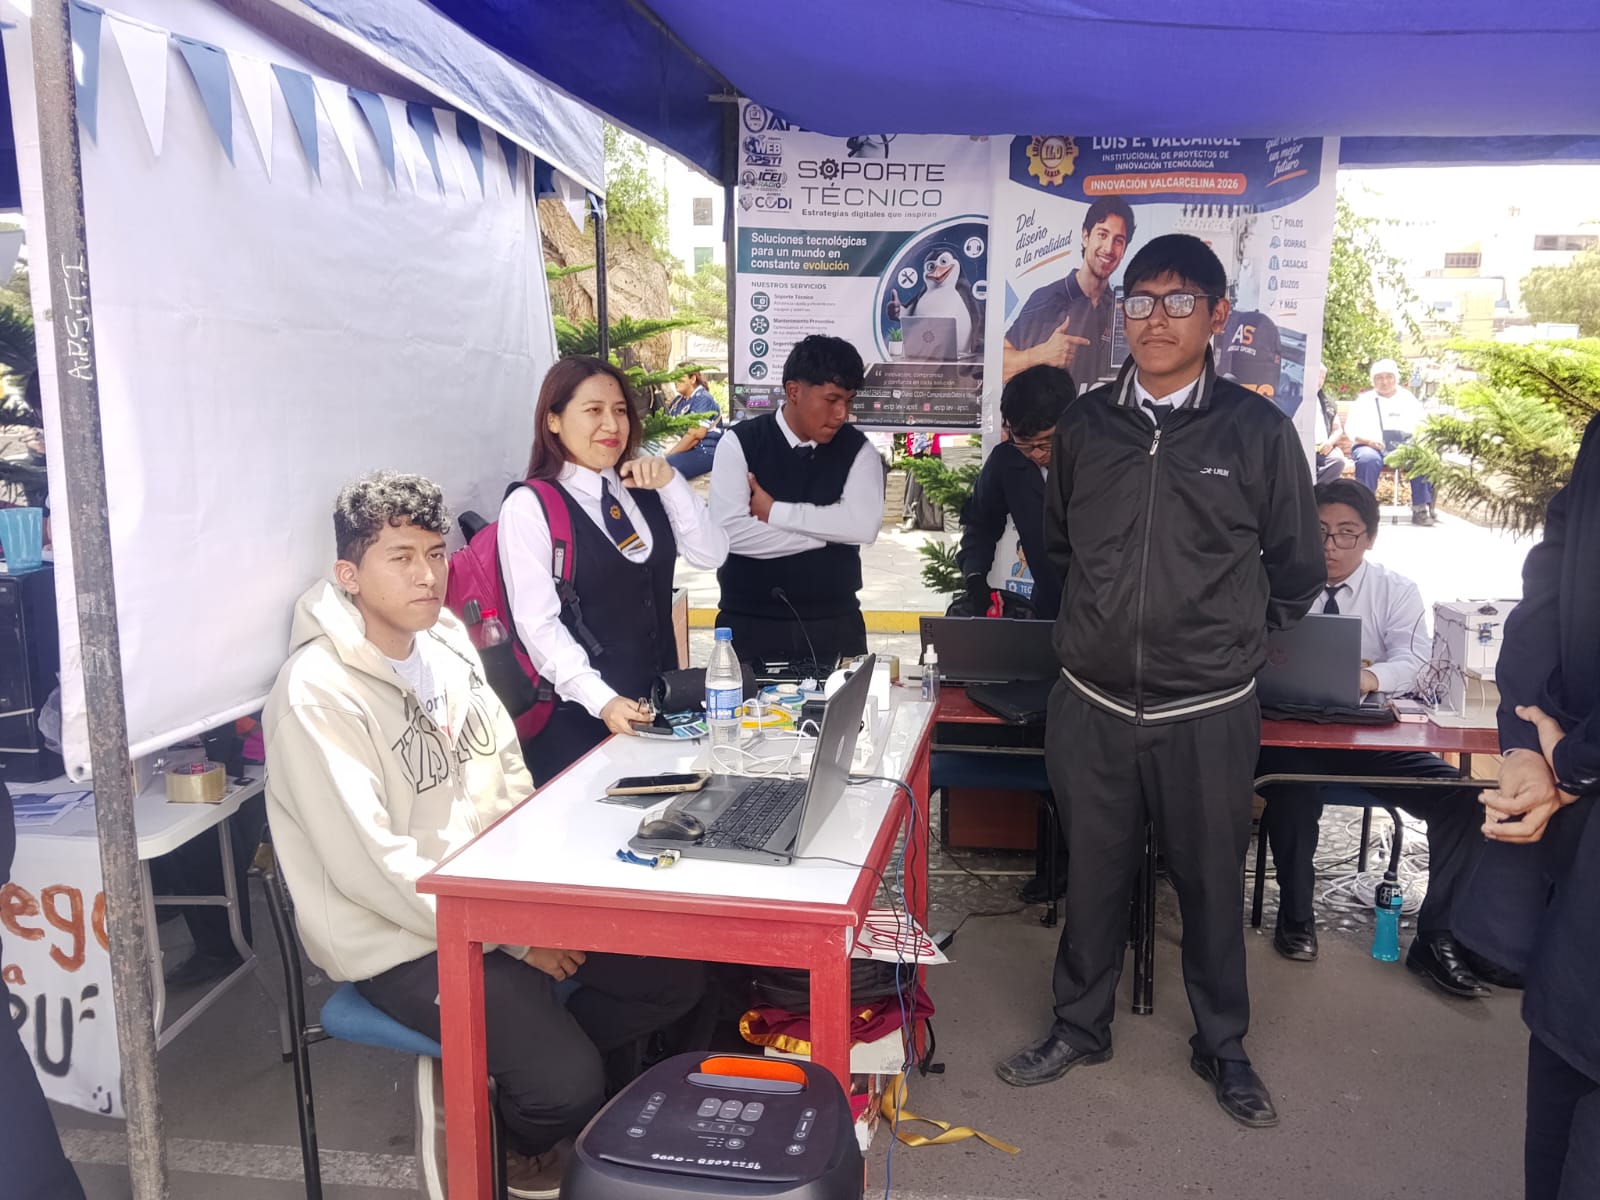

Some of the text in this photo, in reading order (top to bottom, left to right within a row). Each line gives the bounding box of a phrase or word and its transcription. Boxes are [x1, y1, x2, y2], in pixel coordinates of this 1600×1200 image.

[1093, 136, 1128, 150] LUIS
[1102, 150, 1230, 162] INSTITUCIONAL DE PROYECTOS DE
[798, 158, 946, 181] SOPORTE
[1115, 158, 1214, 171] INNOVACIÓN TECNOLÓGICA
[1091, 177, 1239, 190] INNOVACIÓN VALCARCELINA 2026
[800, 182, 942, 207] TÉCNICO
[802, 208, 849, 219] Estrategias
[851, 210, 885, 219] digitales
[904, 211, 937, 219] inspiran
[1016, 208, 1036, 234] Del
[1284, 218, 1304, 228] POLOS
[751, 232, 868, 248] Soluciones tecnológicas
[1015, 225, 1048, 251] diseño
[1283, 238, 1307, 248] GORRAS
[751, 246, 841, 259] para un mundo en
[1023, 249, 1032, 264] la
[1033, 229, 1073, 259] realidad
[750, 260, 850, 271] constante evolución
[1282, 258, 1308, 269] CASACAS
[751, 281, 827, 290] NUESTROS SERVICIOS
[1280, 279, 1299, 289] BUZOS
[1231, 324, 1257, 346] AS
